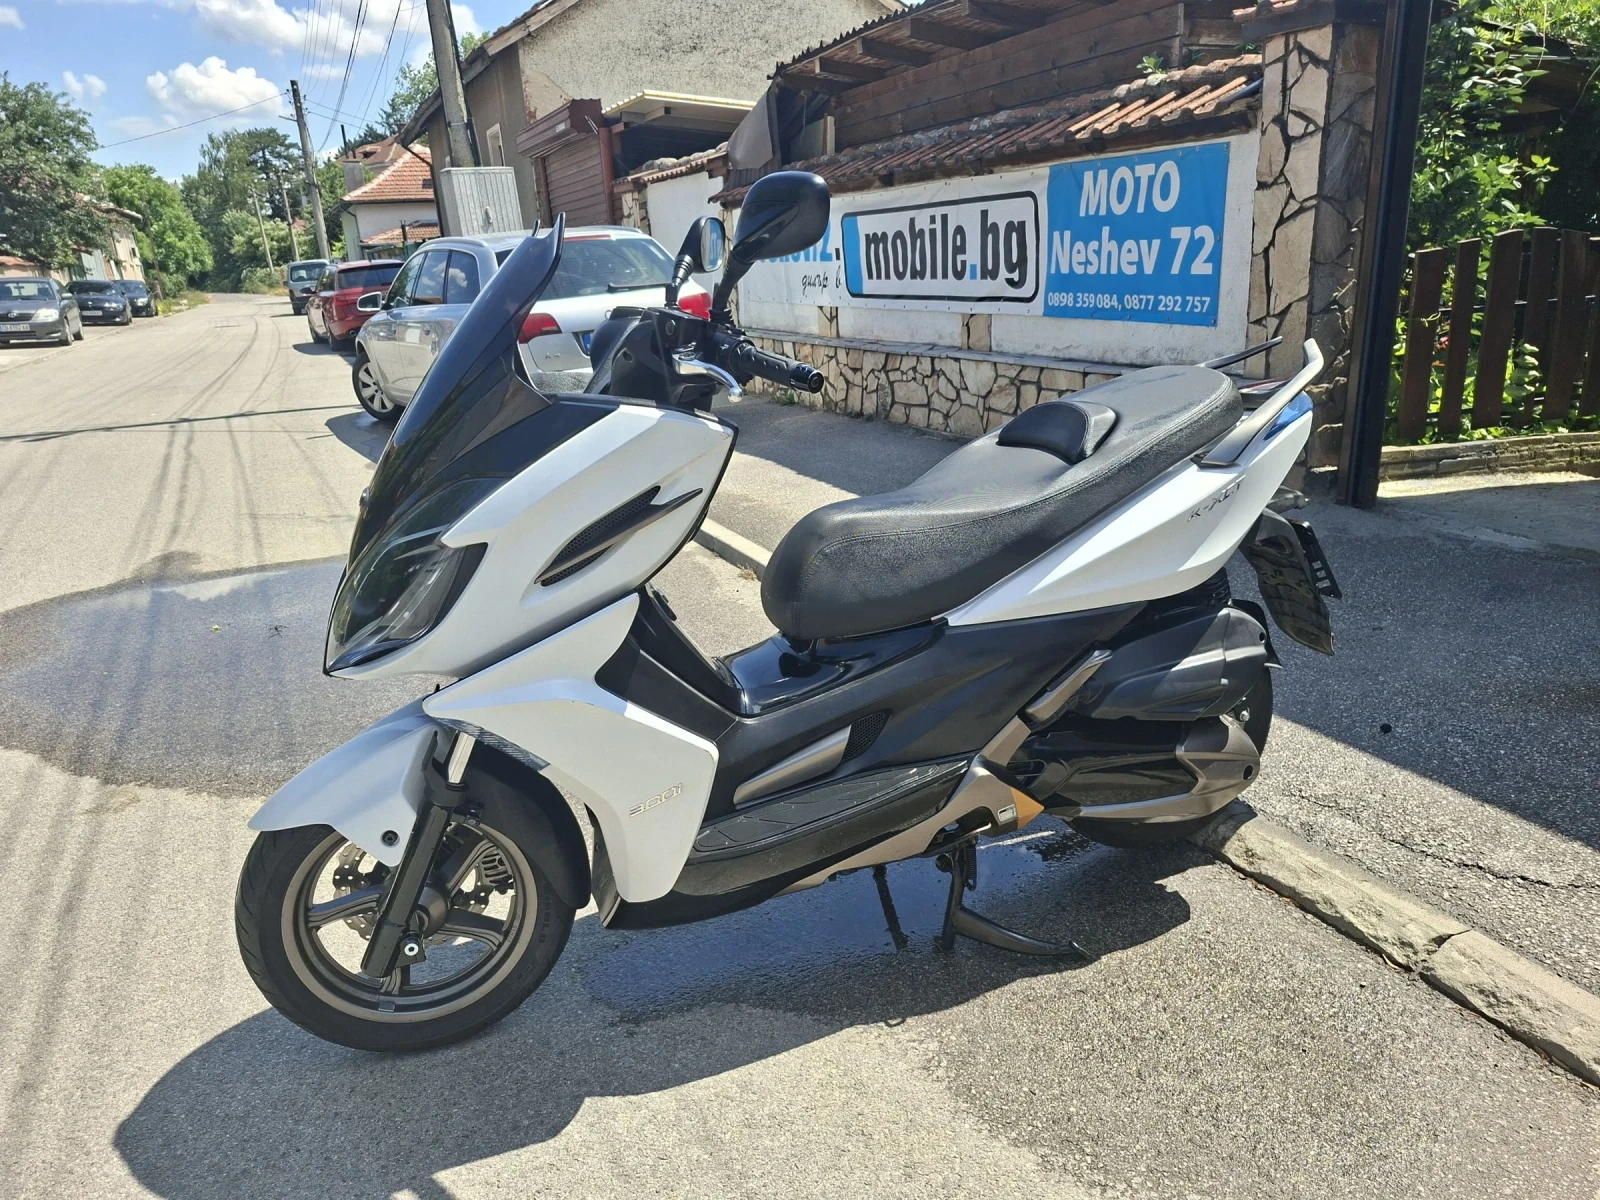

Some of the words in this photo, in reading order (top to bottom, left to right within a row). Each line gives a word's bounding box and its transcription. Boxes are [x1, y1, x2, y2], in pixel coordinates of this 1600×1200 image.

[1079, 160, 1181, 217] MOTO
[864, 209, 1028, 289] mobile.bg
[1050, 226, 1162, 275] Neshev
[1170, 225, 1215, 275] 72
[1048, 292, 1074, 307] 0898
[1075, 293, 1095, 308] 359
[1096, 294, 1122, 311] 084,
[1124, 294, 1155, 310] 0877
[1158, 295, 1182, 312] 292
[1185, 296, 1211, 313] 757
